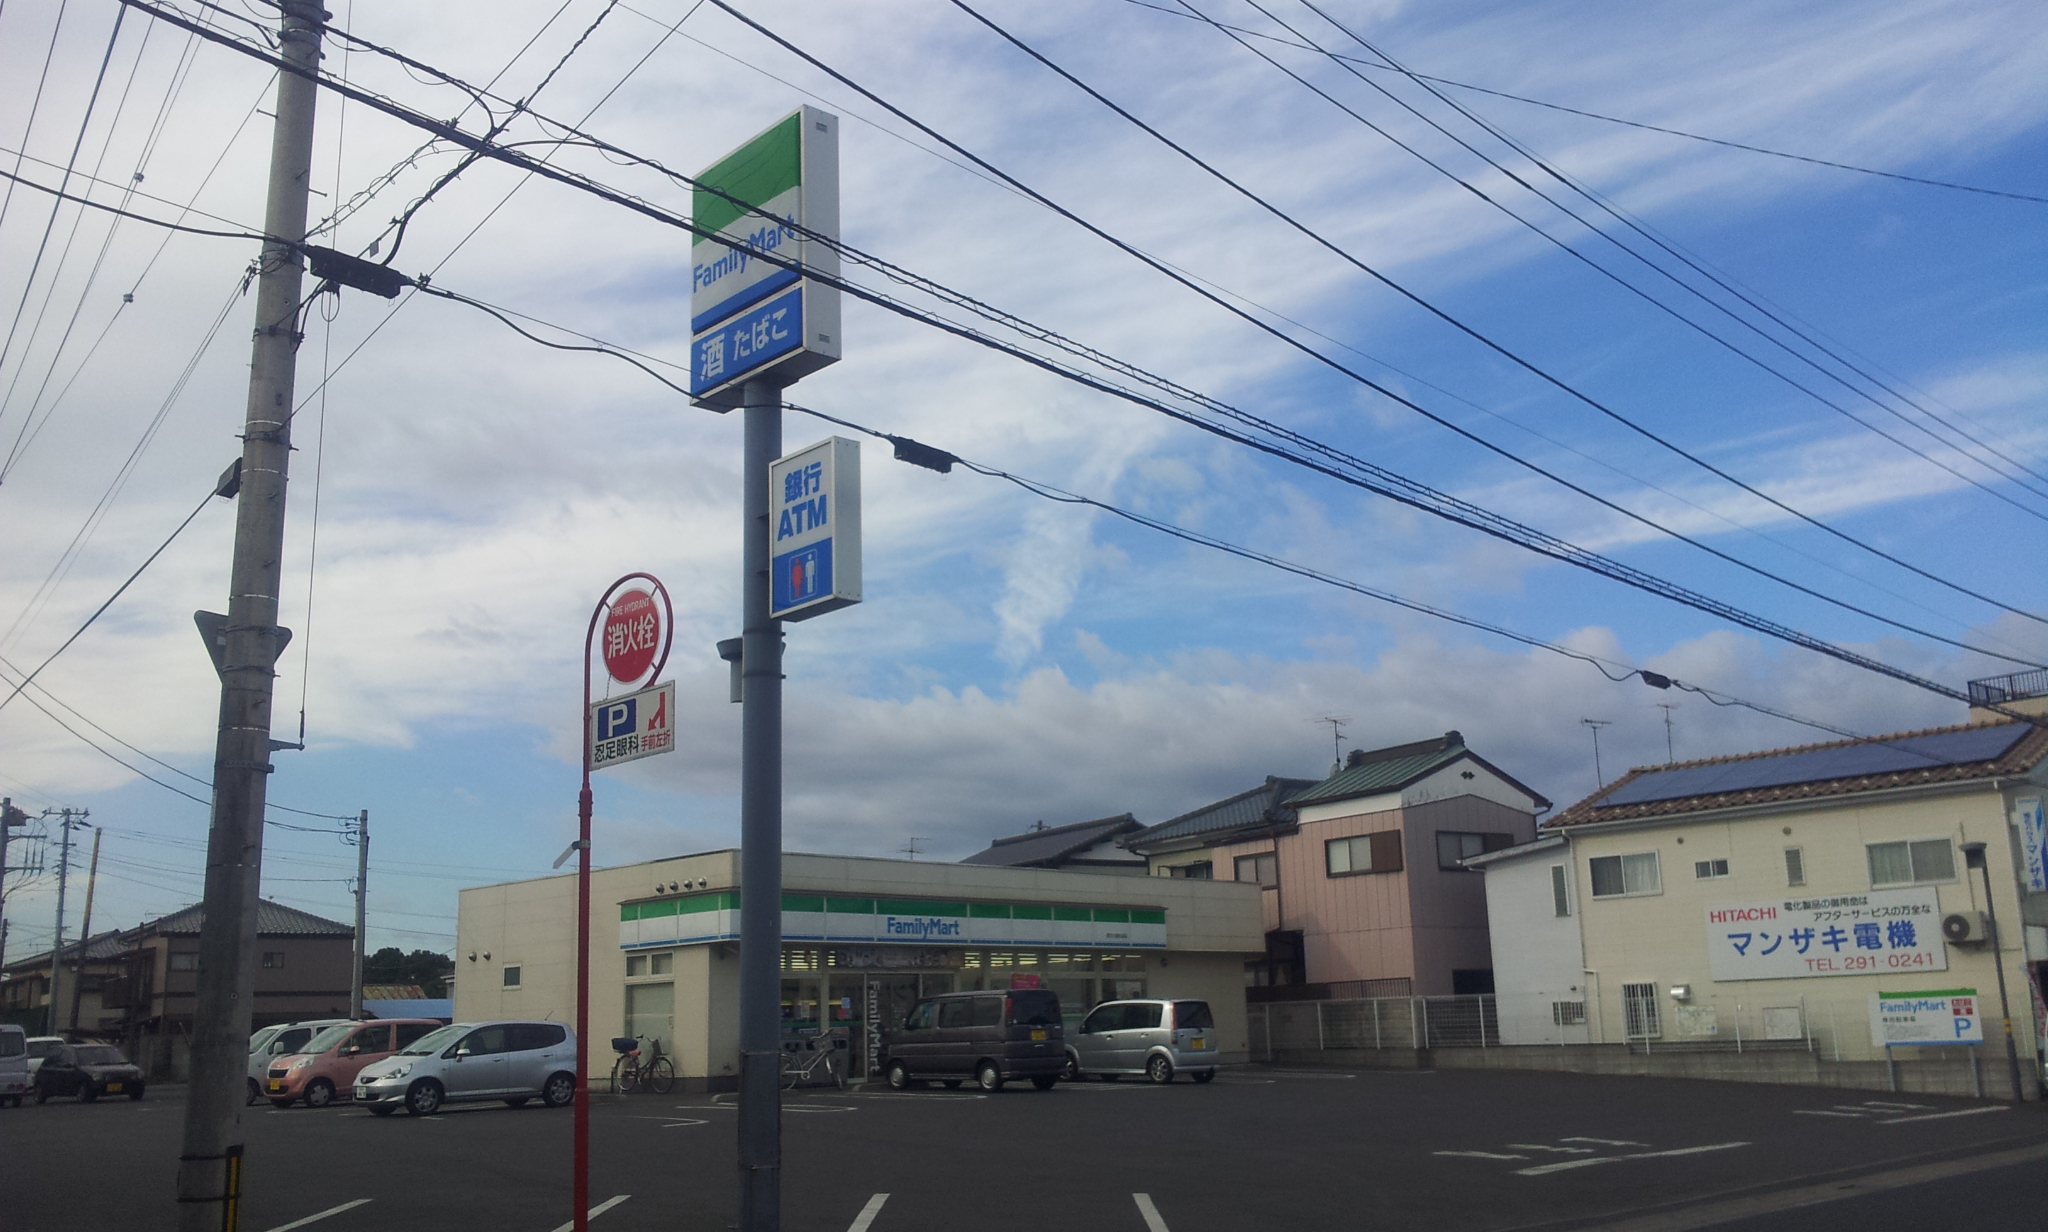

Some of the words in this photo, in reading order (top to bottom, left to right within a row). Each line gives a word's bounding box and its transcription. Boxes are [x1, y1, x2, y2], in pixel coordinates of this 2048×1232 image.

[693, 213, 796, 294] FamilyMart
[700, 333, 725, 381] 酒
[733, 308, 788, 361] たばこ
[784, 461, 822, 503] 銀行
[777, 494, 828, 542] ATM
[611, 605, 624, 617] FIRE
[608, 612, 656, 659] 消火栓
[608, 703, 628, 738] P
[594, 734, 639, 763] 忍足眼科
[641, 731, 671, 752] 手前左折
[887, 916, 960, 939] FamilyMart
[1710, 907, 1777, 923] HITACHI
[1813, 904, 1931, 922] アフターサービスの万全な
[1727, 919, 1917, 957] マンザキ電機
[1805, 958, 1841, 972] TEL
[1880, 1000, 1946, 1014] FamilyMart
[867, 980, 881, 1072] FamilyMart
[1954, 1018, 1972, 1038] P
